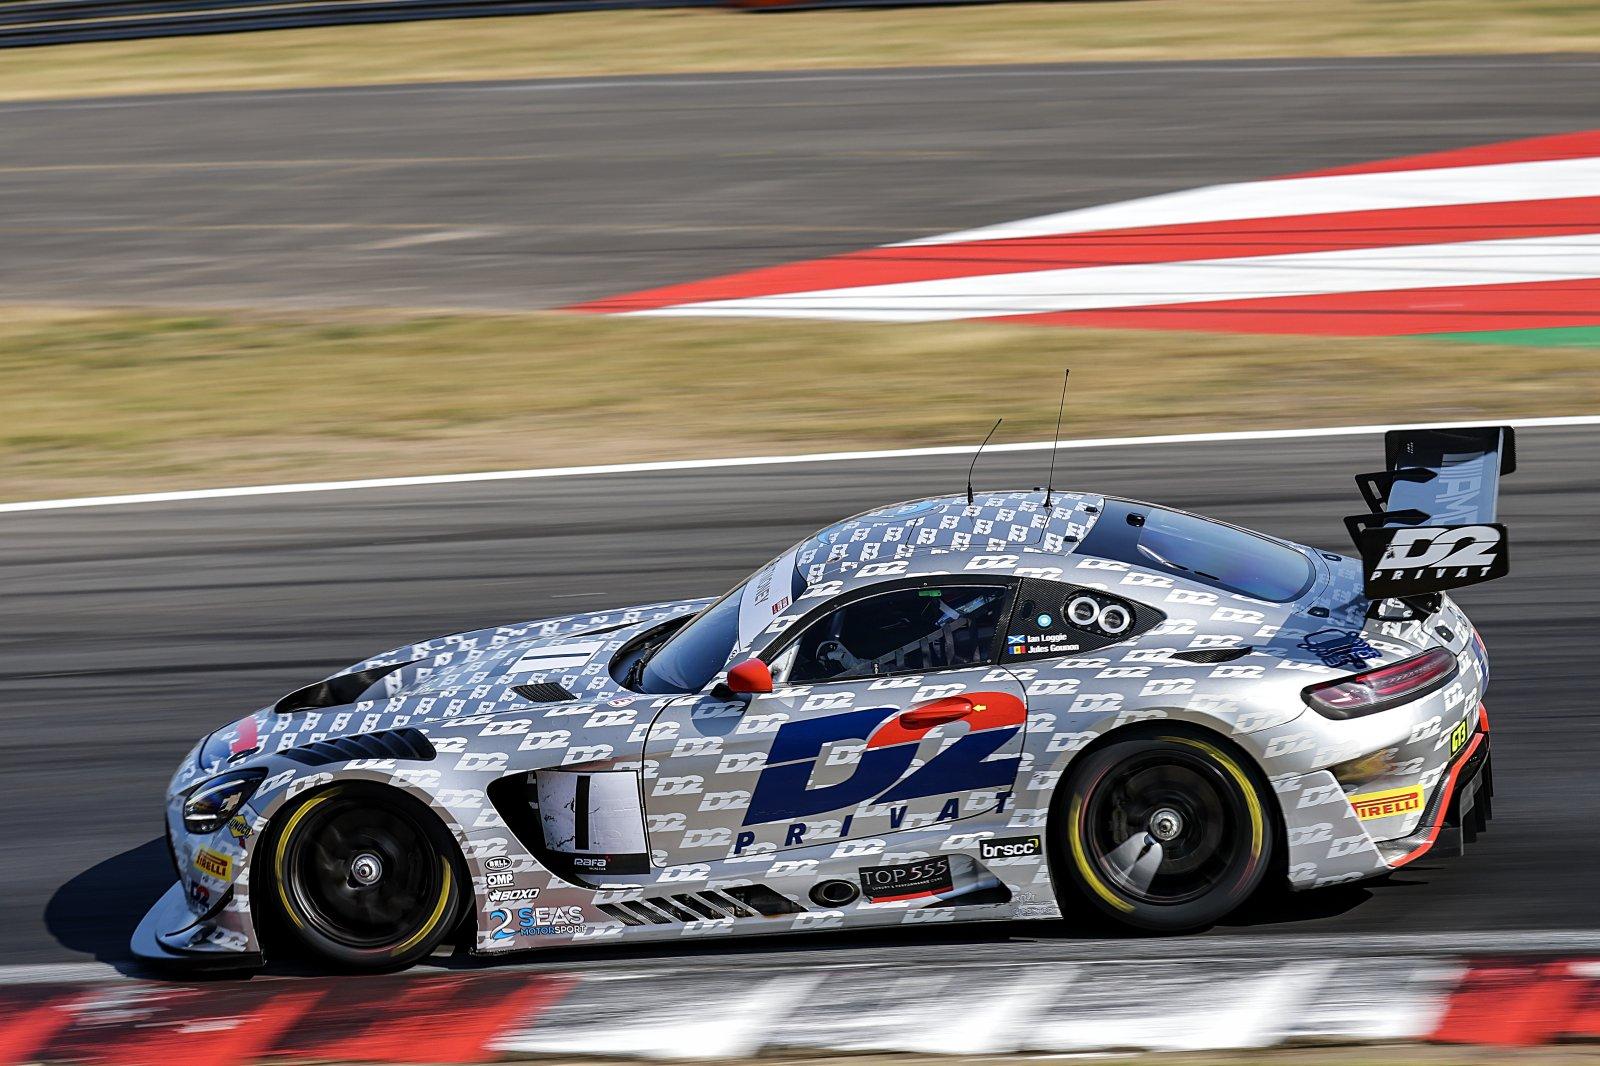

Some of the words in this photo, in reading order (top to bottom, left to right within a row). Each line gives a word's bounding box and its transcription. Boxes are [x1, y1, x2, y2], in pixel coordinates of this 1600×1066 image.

[1374, 526, 1500, 570] D2
[854, 561, 909, 578] D2
[964, 555, 1020, 571] D2
[1075, 558, 1131, 571] D2
[1120, 572, 1175, 588] D2
[1370, 566, 1491, 581] PRIVAT
[797, 580, 843, 600] D2
[1163, 588, 1219, 606] D2
[1209, 607, 1265, 624] D2
[1027, 635, 1040, 643] Ian
[1041, 633, 1067, 643] Loggie
[1187, 634, 1243, 647] D2
[1028, 645, 1049, 653] Jules
[1050, 644, 1080, 652] Gounon
[1053, 658, 1112, 669] D2
[1094, 666, 1152, 678] D2
[1208, 665, 1265, 678] D2
[980, 668, 1038, 682] D2
[1026, 679, 1080, 695] D2
[1138, 678, 1196, 696] D2
[691, 701, 745, 719] D2
[800, 691, 855, 711] D2
[1068, 692, 1124, 712] D2
[478, 719, 532, 736] D2
[583, 709, 637, 728] D2
[735, 713, 789, 735] D2
[627, 721, 680, 742] D2
[1406, 715, 1442, 745] D2
[1452, 722, 1466, 753] GT3
[517, 730, 571, 751] D2
[671, 736, 723, 758] D2
[454, 752, 509, 771] D2
[715, 752, 768, 774] D2
[742, 691, 1027, 826] D2
[254, 769, 296, 800] D2
[389, 769, 441, 788] D2
[651, 775, 704, 796] D2
[429, 789, 484, 808] D2
[698, 790, 751, 812] D2
[734, 791, 1013, 855] PRIVAT
[679, 827, 732, 848] D2
[831, 839, 886, 858] D2
[983, 842, 1035, 858] brscc
[656, 863, 711, 882] D2
[765, 859, 819, 878] D2
[860, 869, 906, 885] TOP
[909, 859, 948, 881] 555
[487, 874, 513, 885] OMP
[499, 888, 540, 900] BOXO
[518, 906, 585, 927] SEAS
[791, 910, 845, 929] D2
[520, 925, 586, 936] MOTORSPORT
